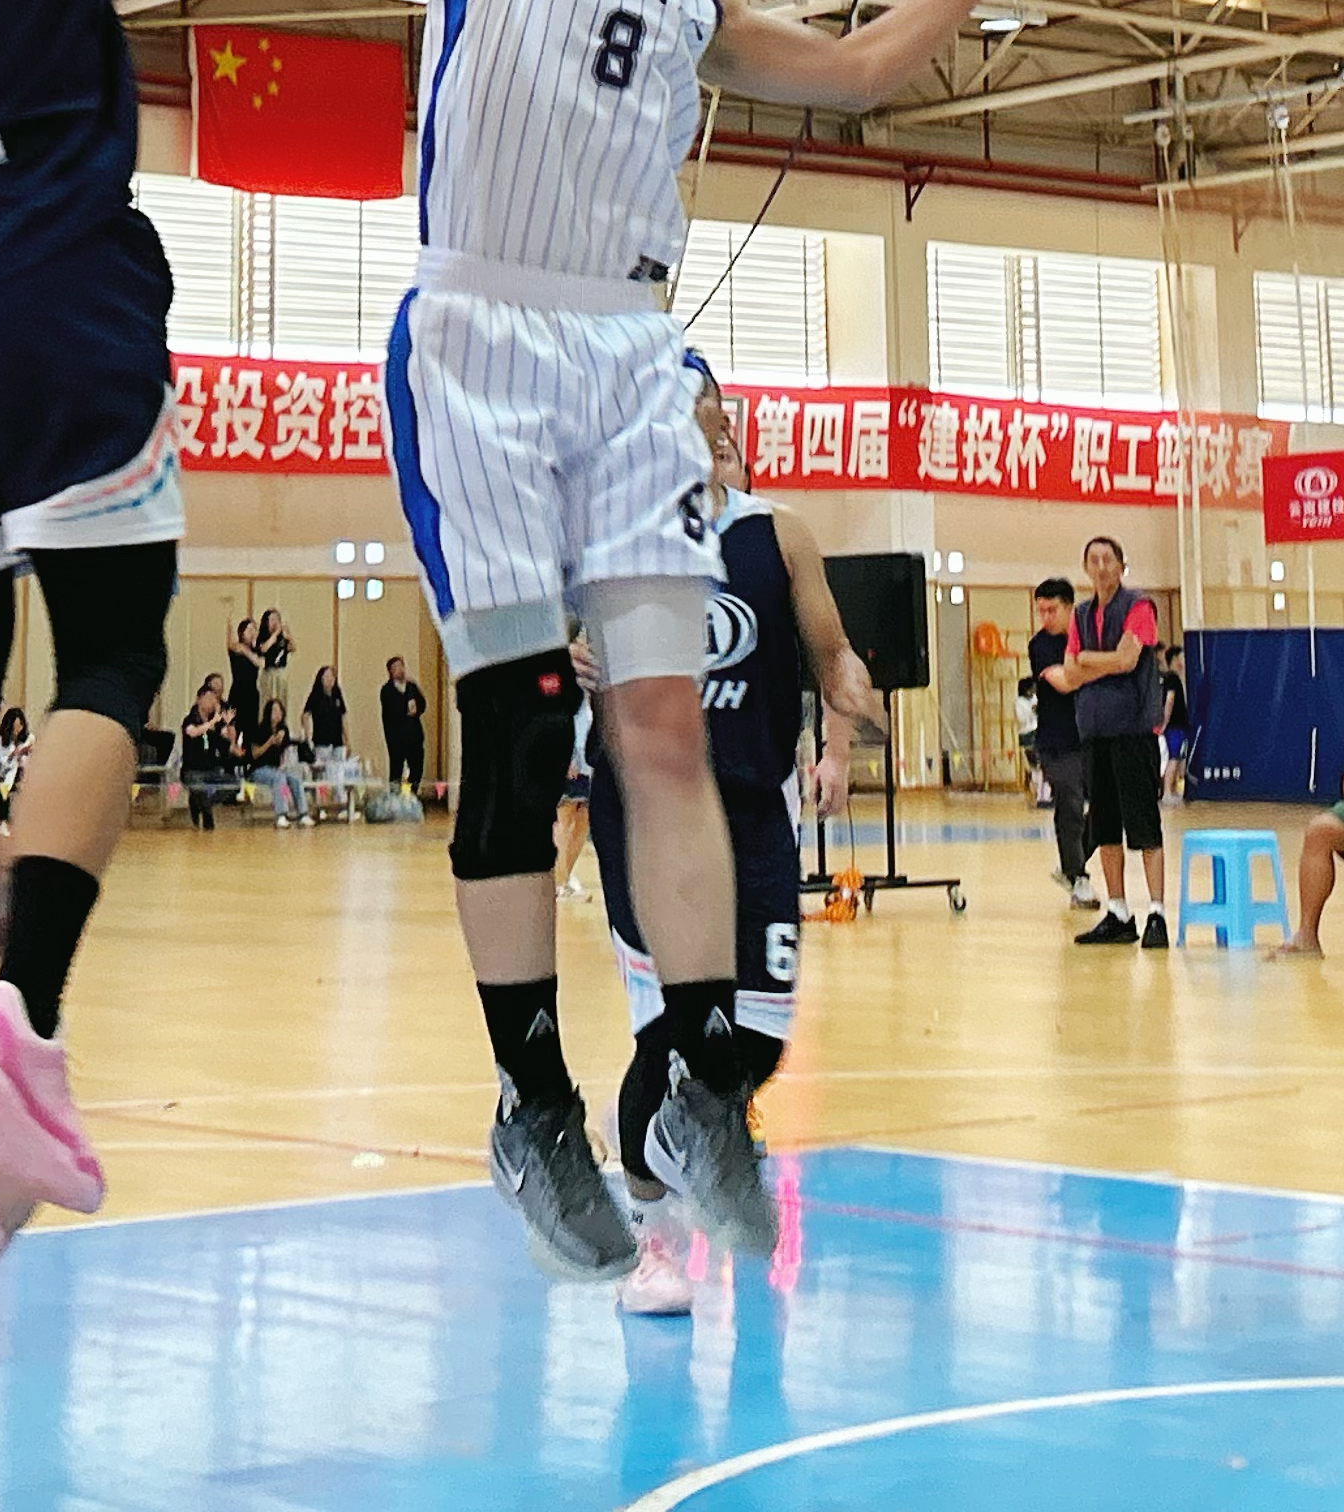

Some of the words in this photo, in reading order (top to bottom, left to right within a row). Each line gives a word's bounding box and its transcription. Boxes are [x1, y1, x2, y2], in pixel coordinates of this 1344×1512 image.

[592, 9, 647, 88] 8
[702, 679, 750, 709] IH
[765, 922, 798, 981] 6
